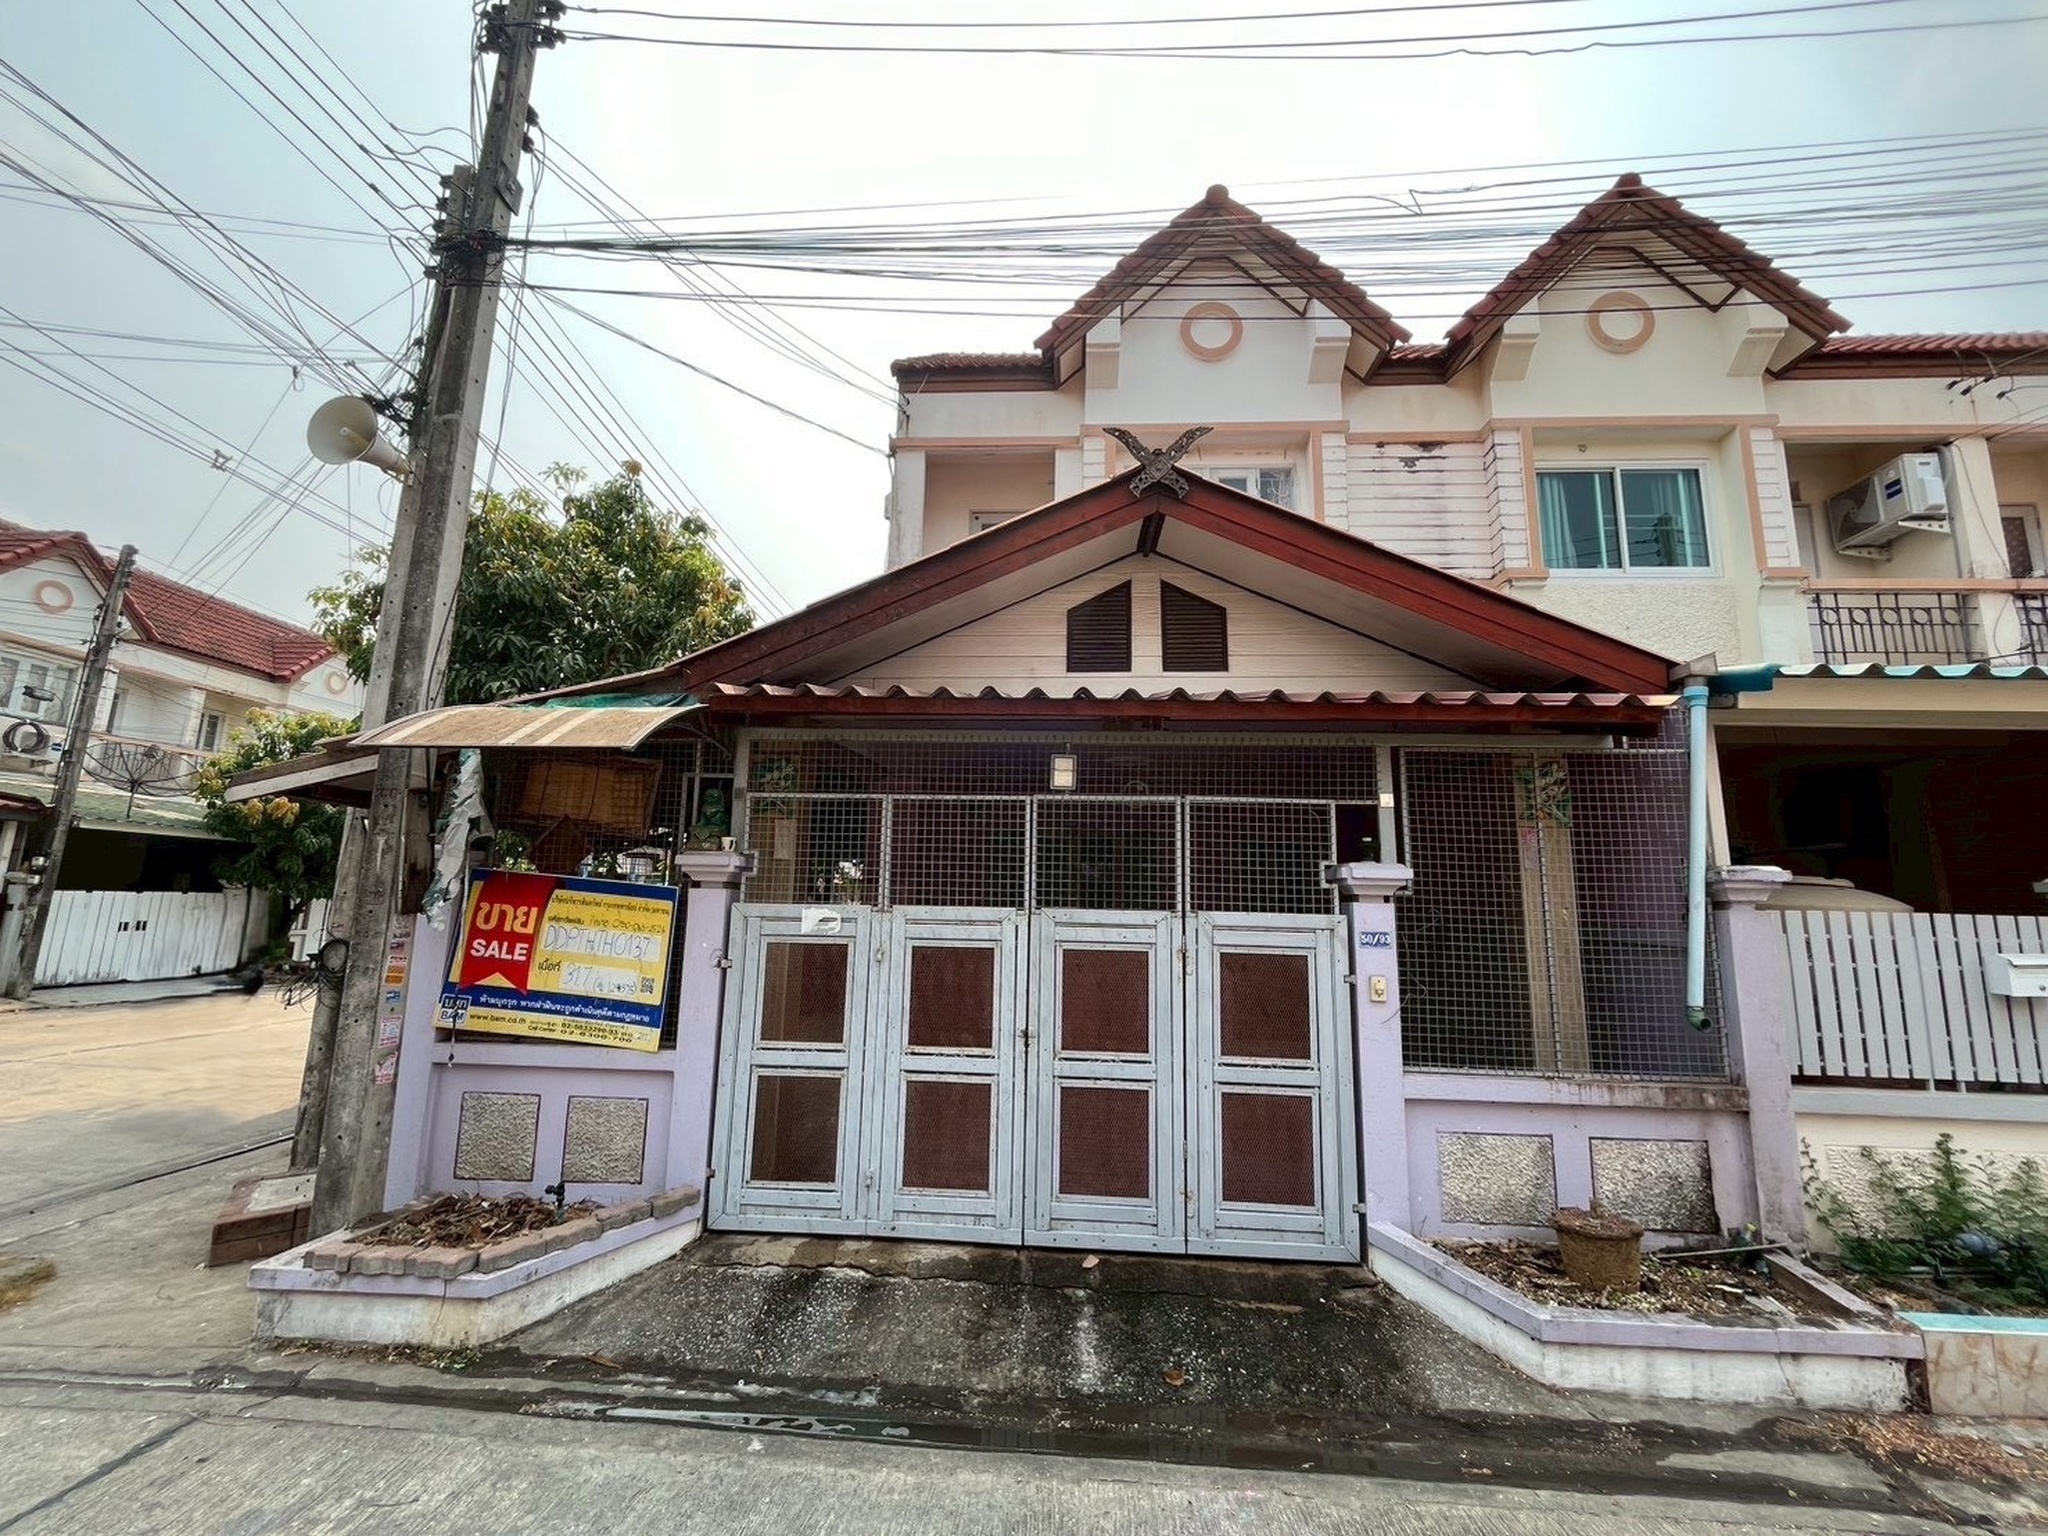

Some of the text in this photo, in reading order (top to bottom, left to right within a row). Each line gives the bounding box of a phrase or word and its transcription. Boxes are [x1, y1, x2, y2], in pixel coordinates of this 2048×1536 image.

[476, 902, 538, 934] ขาย
[470, 938, 529, 961] SALE
[469, 1013, 526, 1025] www.bam.co.th
